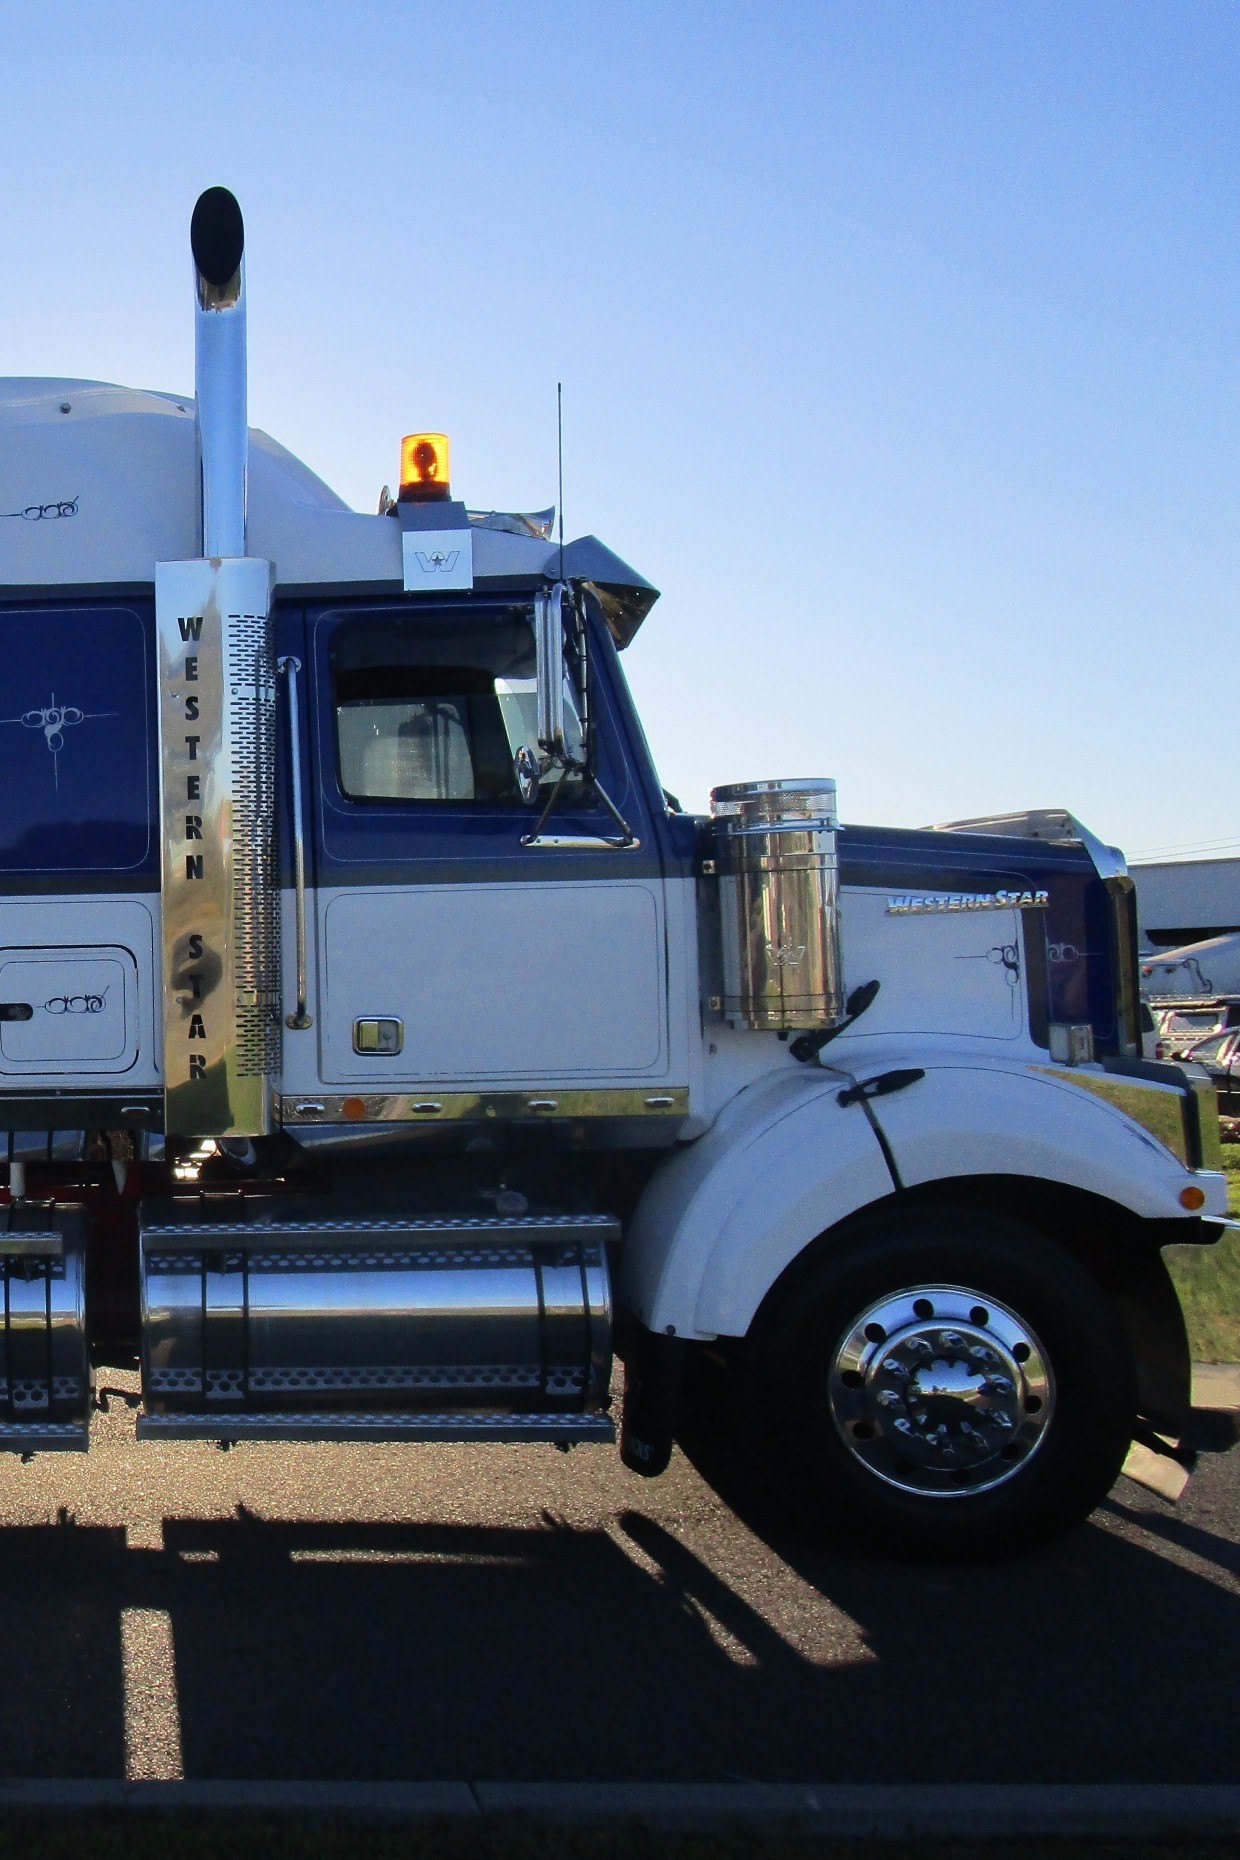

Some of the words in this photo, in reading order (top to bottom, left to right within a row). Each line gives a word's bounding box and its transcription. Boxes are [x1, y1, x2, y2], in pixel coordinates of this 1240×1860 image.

[177, 616, 204, 881] WESTERN
[887, 894, 991, 913] WESTERN
[995, 889, 1049, 907] STAR
[187, 934, 207, 1081] STAR
